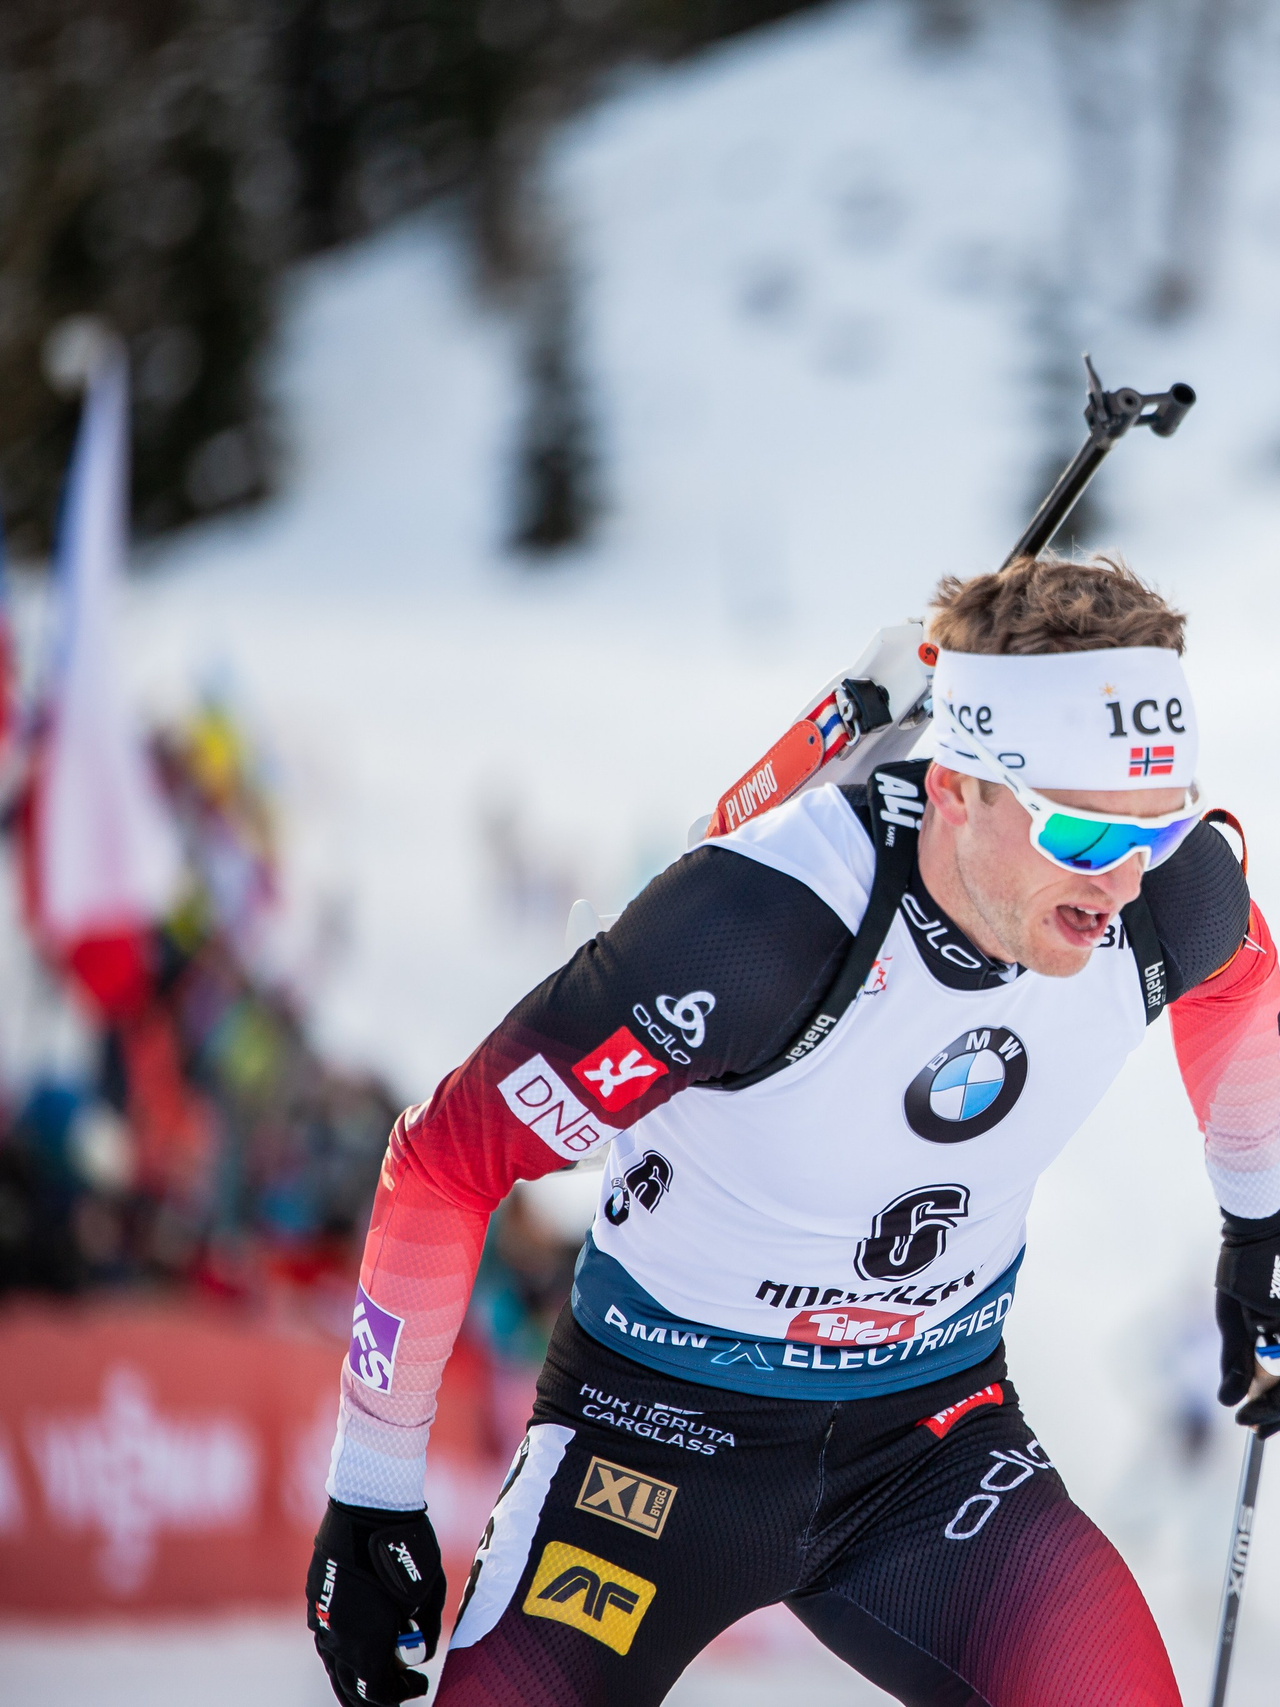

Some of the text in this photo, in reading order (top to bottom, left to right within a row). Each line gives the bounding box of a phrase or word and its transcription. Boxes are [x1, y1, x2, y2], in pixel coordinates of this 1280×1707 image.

[1106, 697, 1187, 738] ice
[724, 762, 778, 831] PLUMBO
[632, 1003, 692, 1065] odlo
[784, 1013, 838, 1066] biatar
[926, 1029, 1023, 1073] BMW
[515, 1074, 600, 1152] DNB
[853, 1182, 971, 1282] 6
[781, 1292, 1013, 1370] ELECTRIFIED
[579, 1383, 736, 1447] HURTIGRUTA
[582, 1404, 718, 1456] CARGLASS
[583, 1466, 658, 1530] XL
[650, 1489, 668, 1518] BYGG
